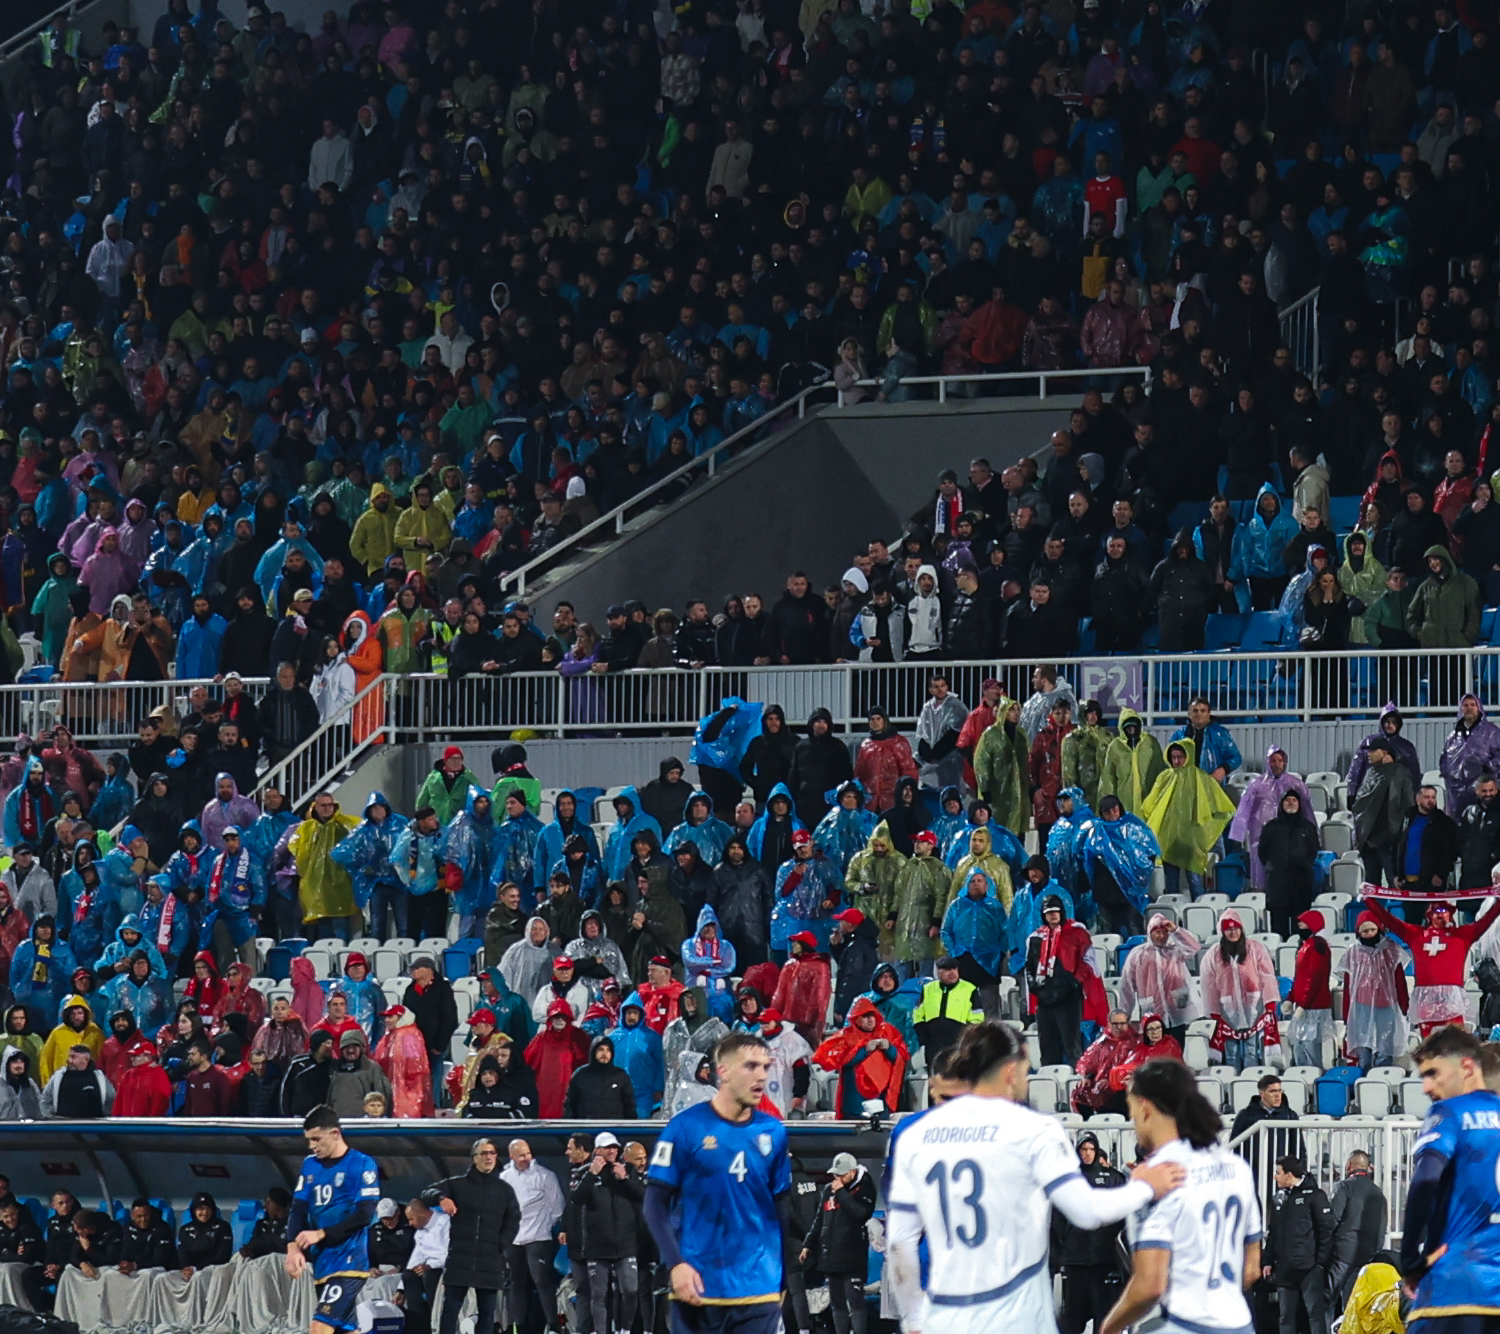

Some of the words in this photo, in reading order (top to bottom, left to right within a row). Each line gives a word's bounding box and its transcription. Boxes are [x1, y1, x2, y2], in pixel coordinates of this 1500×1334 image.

[1084, 665, 1127, 706] P2
[922, 1125, 1000, 1146] RODRIGUEZ
[729, 1150, 748, 1183] 4
[313, 1183, 333, 1206] 19
[925, 1158, 988, 1250] 13
[319, 1284, 342, 1304] 19
